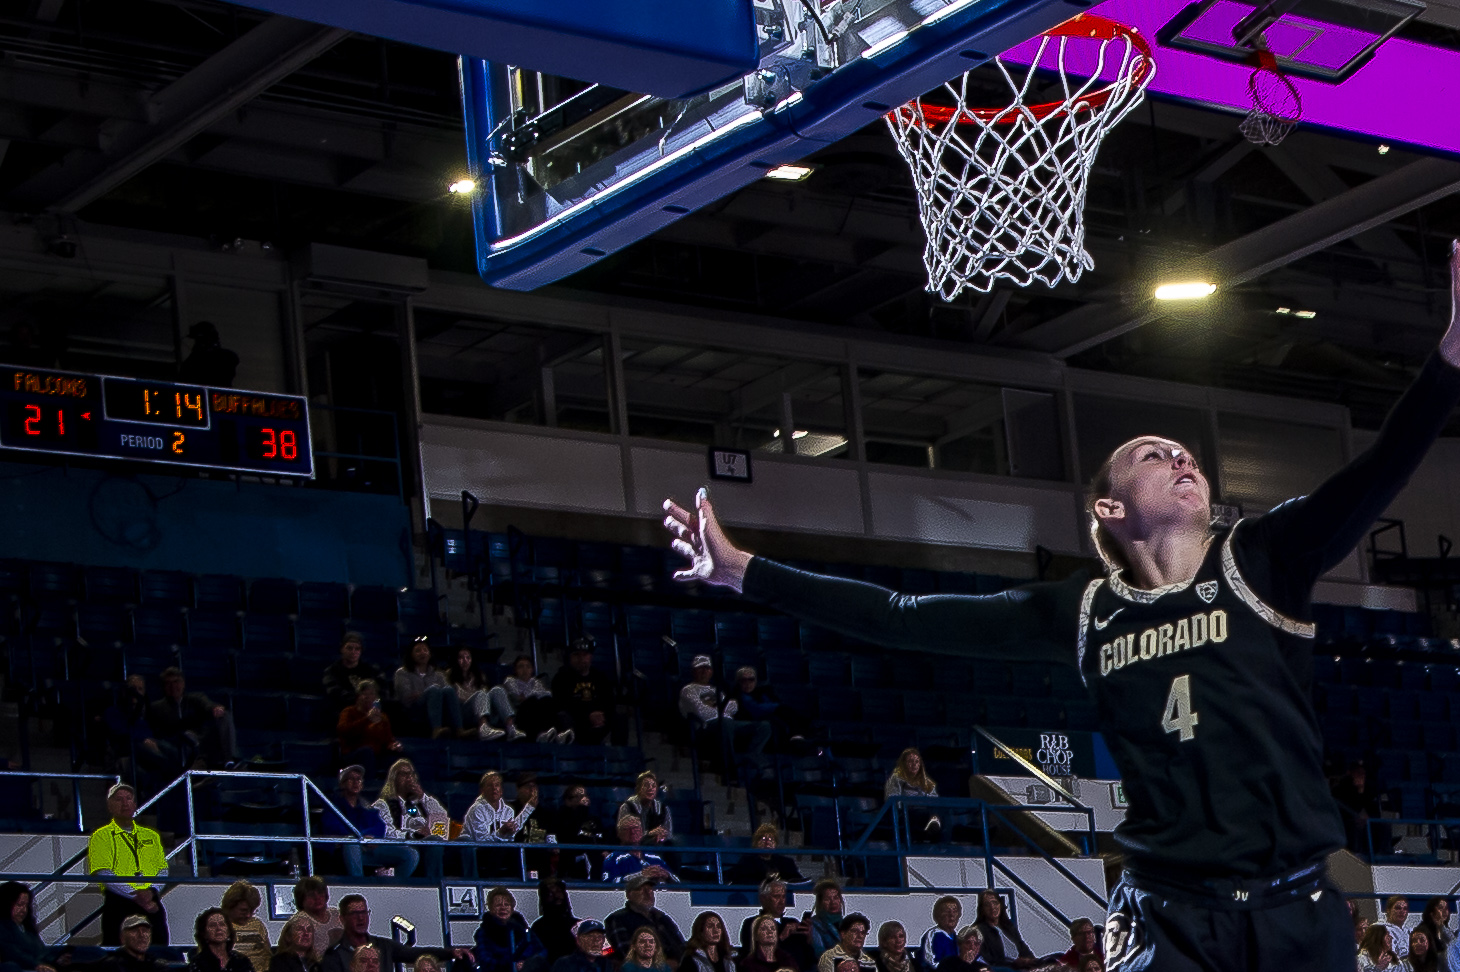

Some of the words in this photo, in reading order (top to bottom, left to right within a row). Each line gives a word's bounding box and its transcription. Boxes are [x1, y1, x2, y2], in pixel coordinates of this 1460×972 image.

[144, 389, 203, 421] 1:14
[25, 404, 65, 435] 21
[121, 434, 164, 450] PERIOD
[172, 431, 185, 453] 2
[260, 428, 298, 460] 38
[1100, 610, 1228, 677] COLORADO
[1161, 674, 1199, 742] 4
[1037, 749, 1074, 765] CHOP
[1042, 764, 1073, 776] HOUSE
[449, 887, 474, 908] L4
